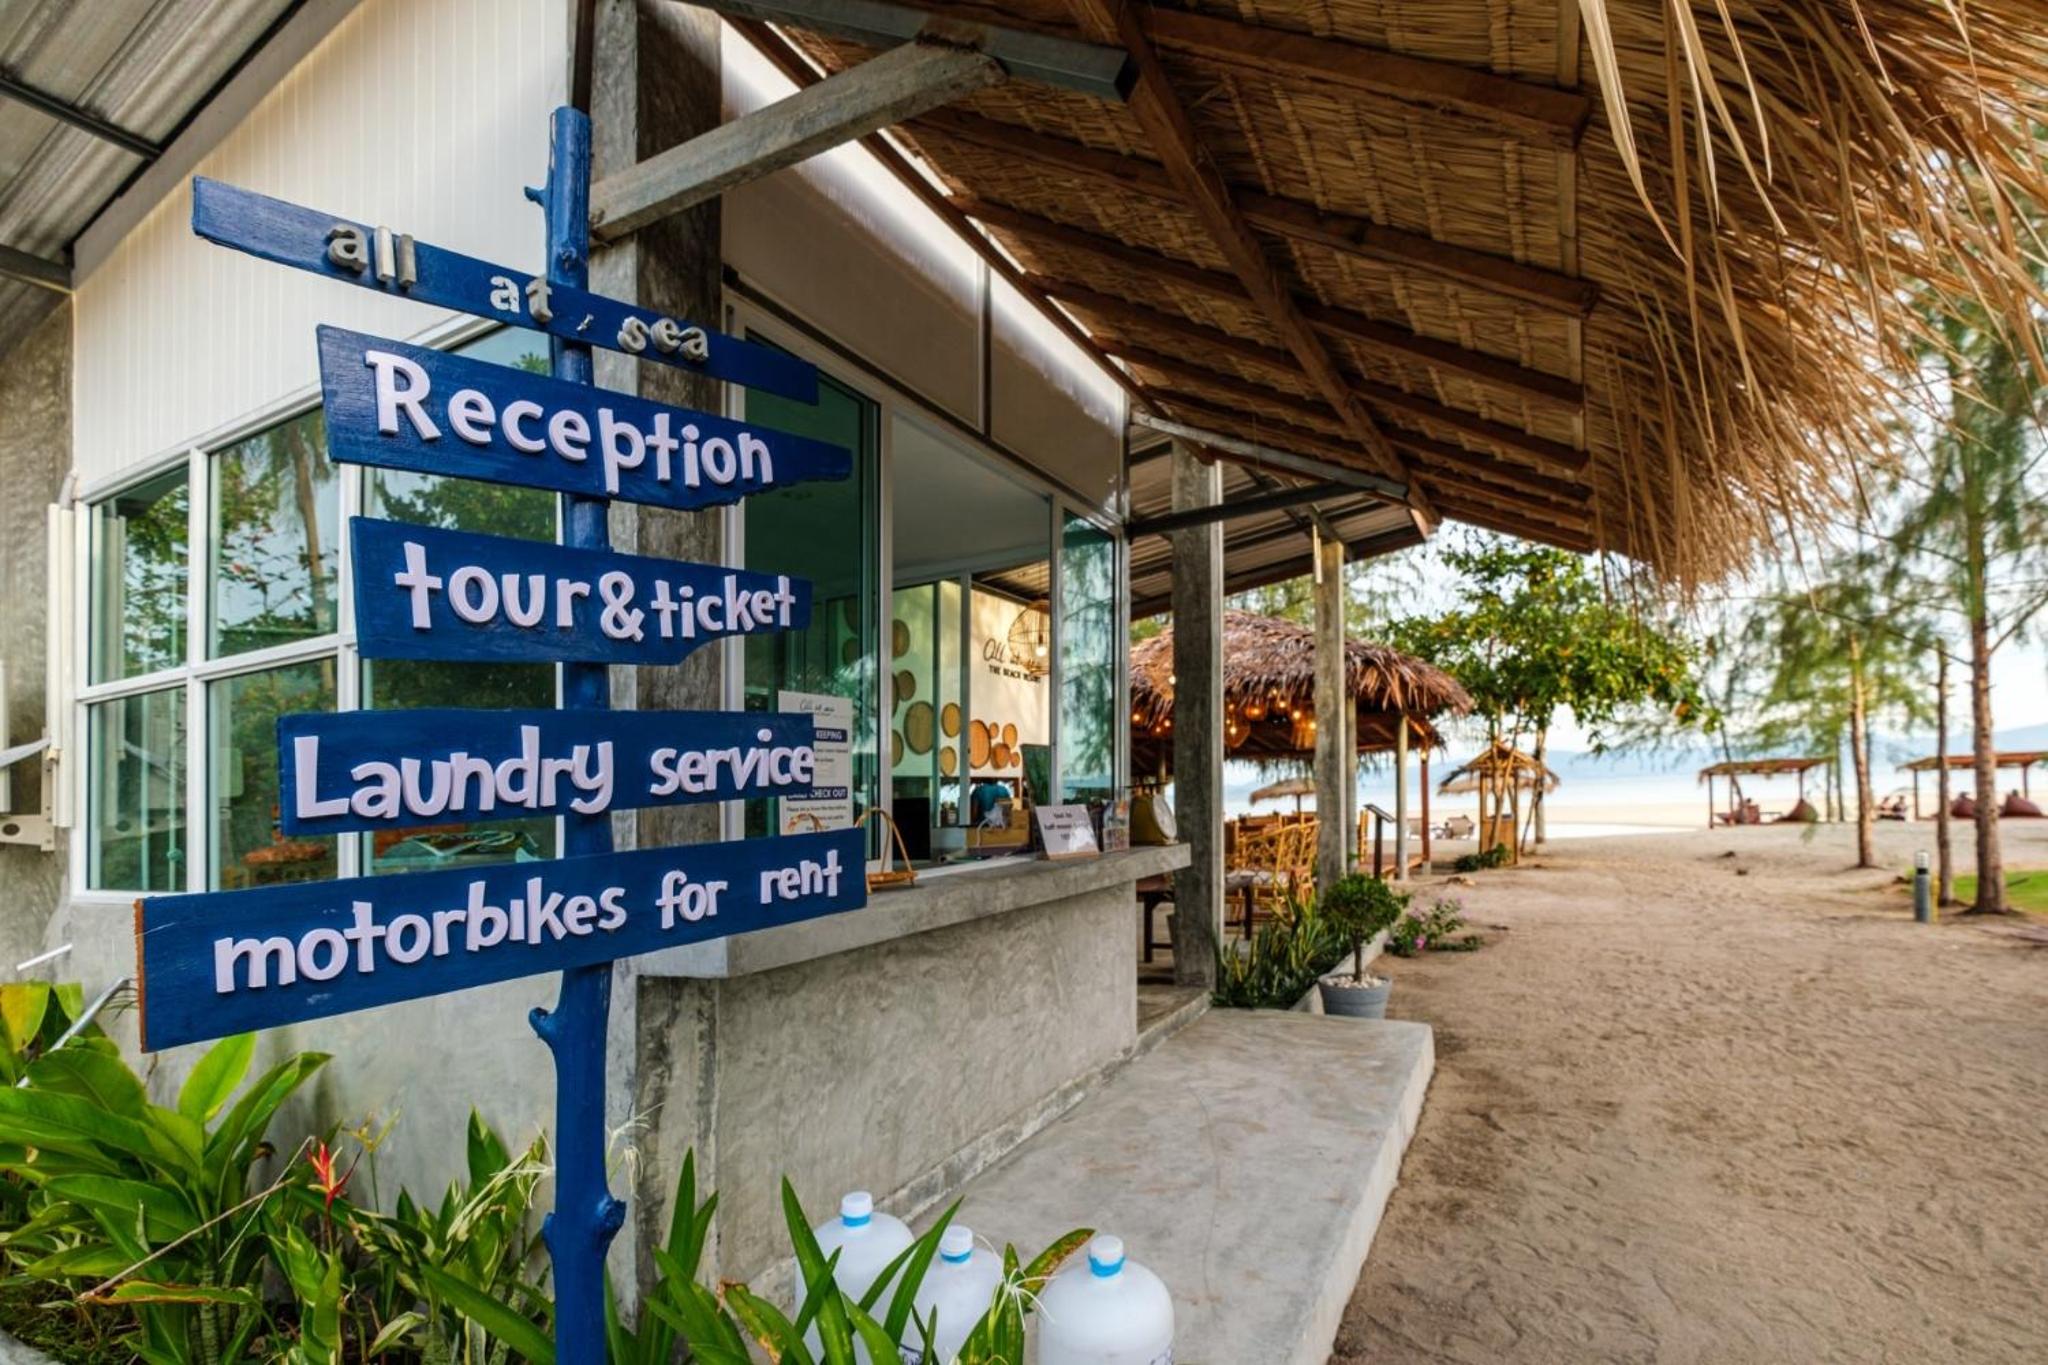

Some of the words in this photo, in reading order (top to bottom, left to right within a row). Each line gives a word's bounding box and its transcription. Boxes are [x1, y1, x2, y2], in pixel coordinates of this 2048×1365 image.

[327, 223, 417, 288] all
[490, 275, 553, 324] at
[617, 315, 709, 363] sea
[364, 348, 774, 495] Reception
[293, 724, 614, 819] Laundry
[649, 728, 815, 790] service
[213, 880, 627, 993] motorbikes
[655, 870, 728, 930] for
[760, 849, 843, 904] rent
